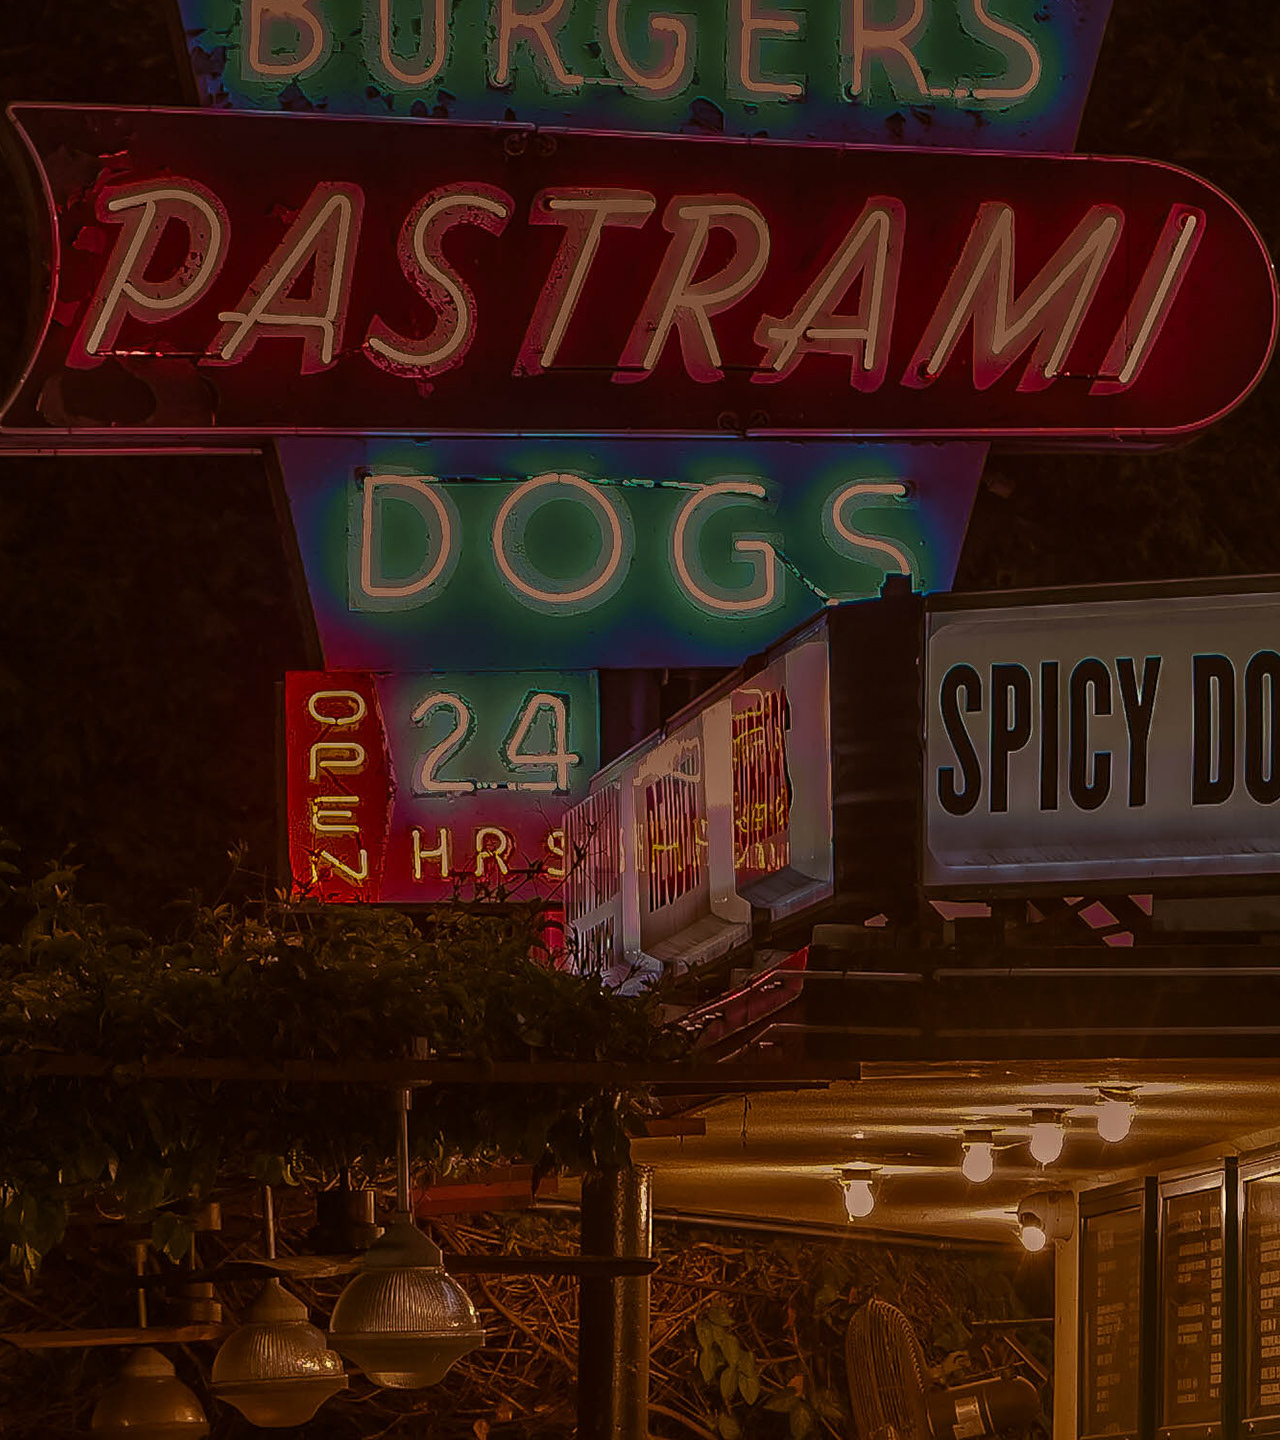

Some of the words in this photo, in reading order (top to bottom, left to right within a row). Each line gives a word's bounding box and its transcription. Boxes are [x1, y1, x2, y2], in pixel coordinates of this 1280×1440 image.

[64, 180, 1206, 398] PASTRAMI
[348, 468, 928, 620] DOGS
[304, 688, 370, 885] OPEN
[410, 688, 582, 796] 24
[936, 656, 1162, 818] SPICY
